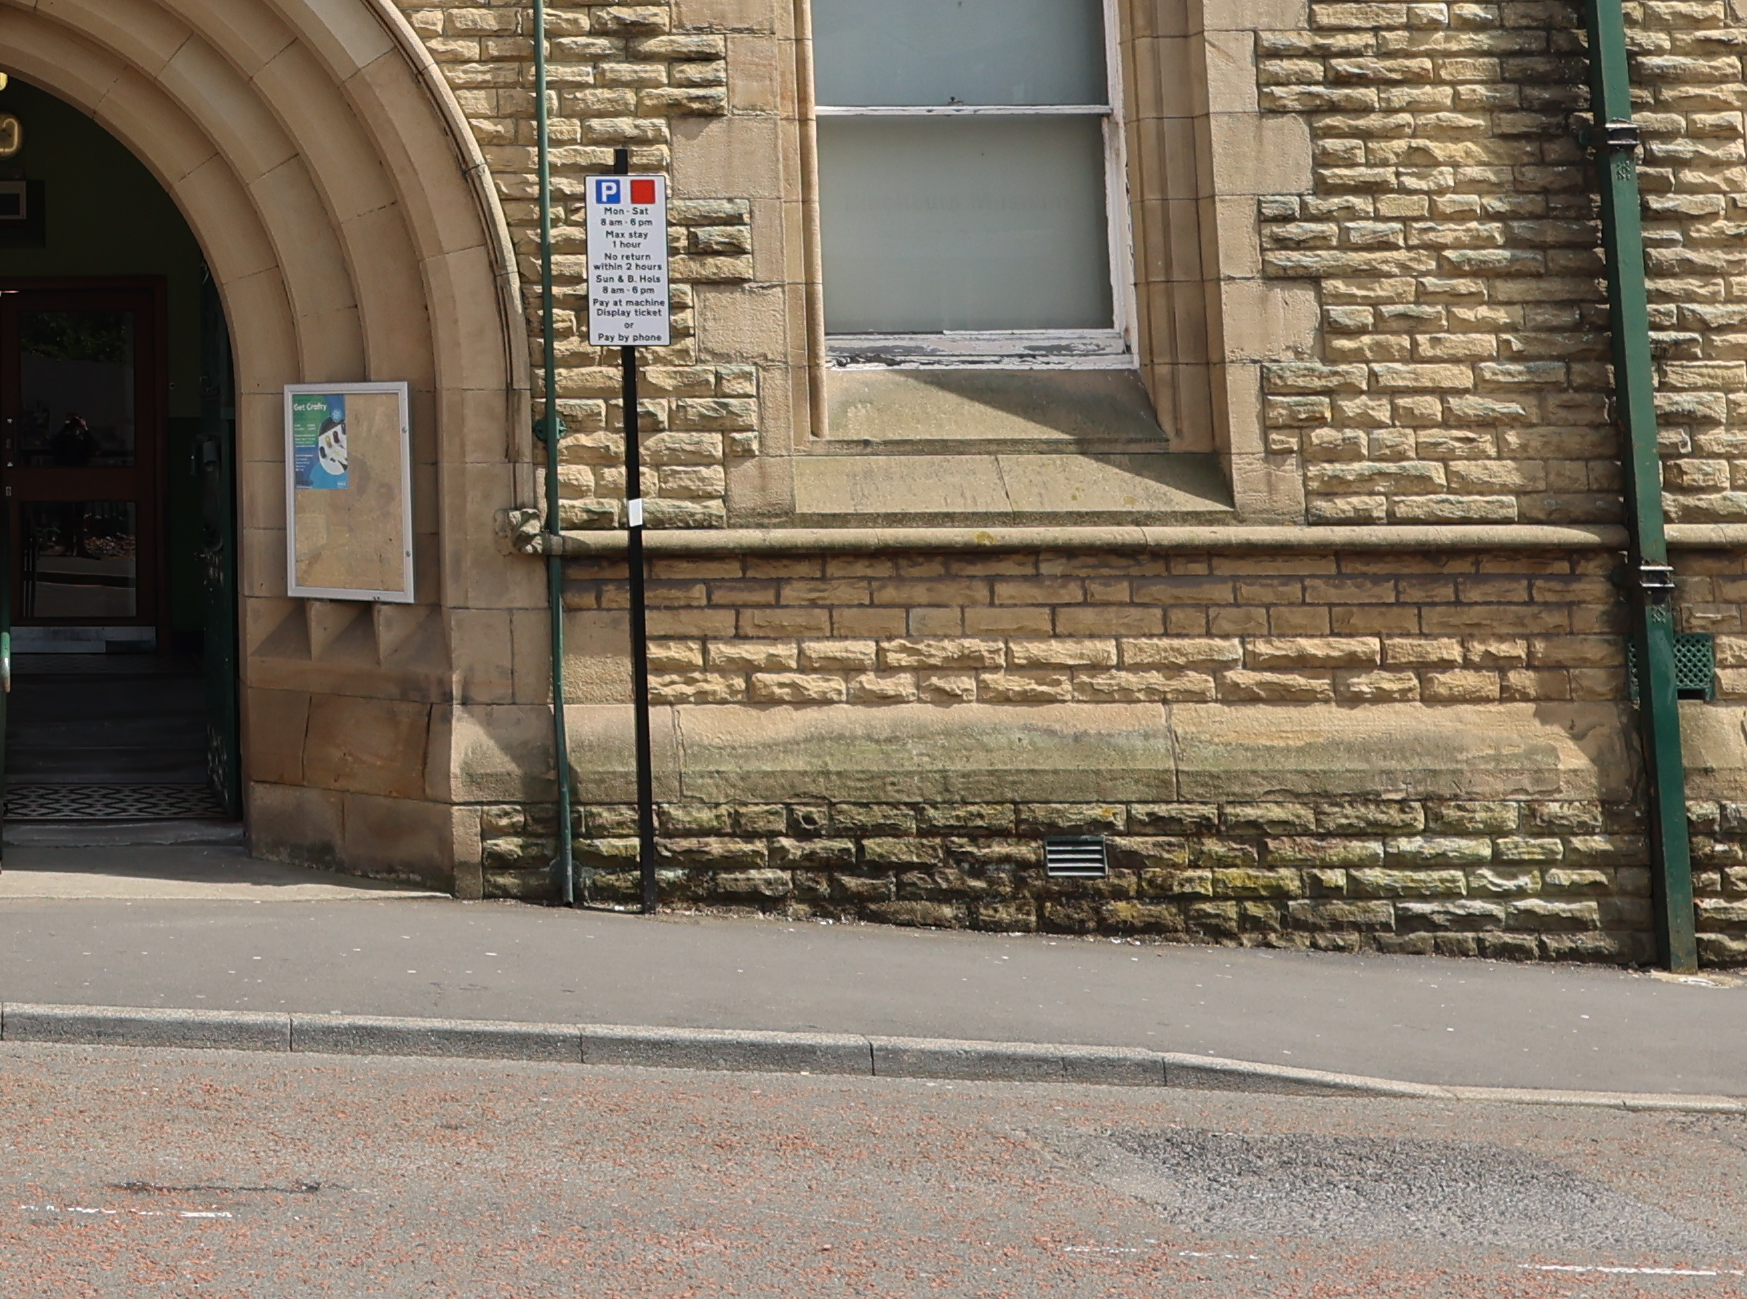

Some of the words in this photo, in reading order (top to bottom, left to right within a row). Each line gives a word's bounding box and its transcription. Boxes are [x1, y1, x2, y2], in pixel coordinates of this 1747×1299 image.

[602, 182, 617, 202] P
[629, 231, 648, 240] stay
[593, 299, 609, 308] Pay
[597, 309, 631, 318] Display
[598, 334, 615, 343] Pay
[619, 334, 629, 343] by
[633, 334, 661, 342] phone
[307, 403, 327, 411] Crafty
